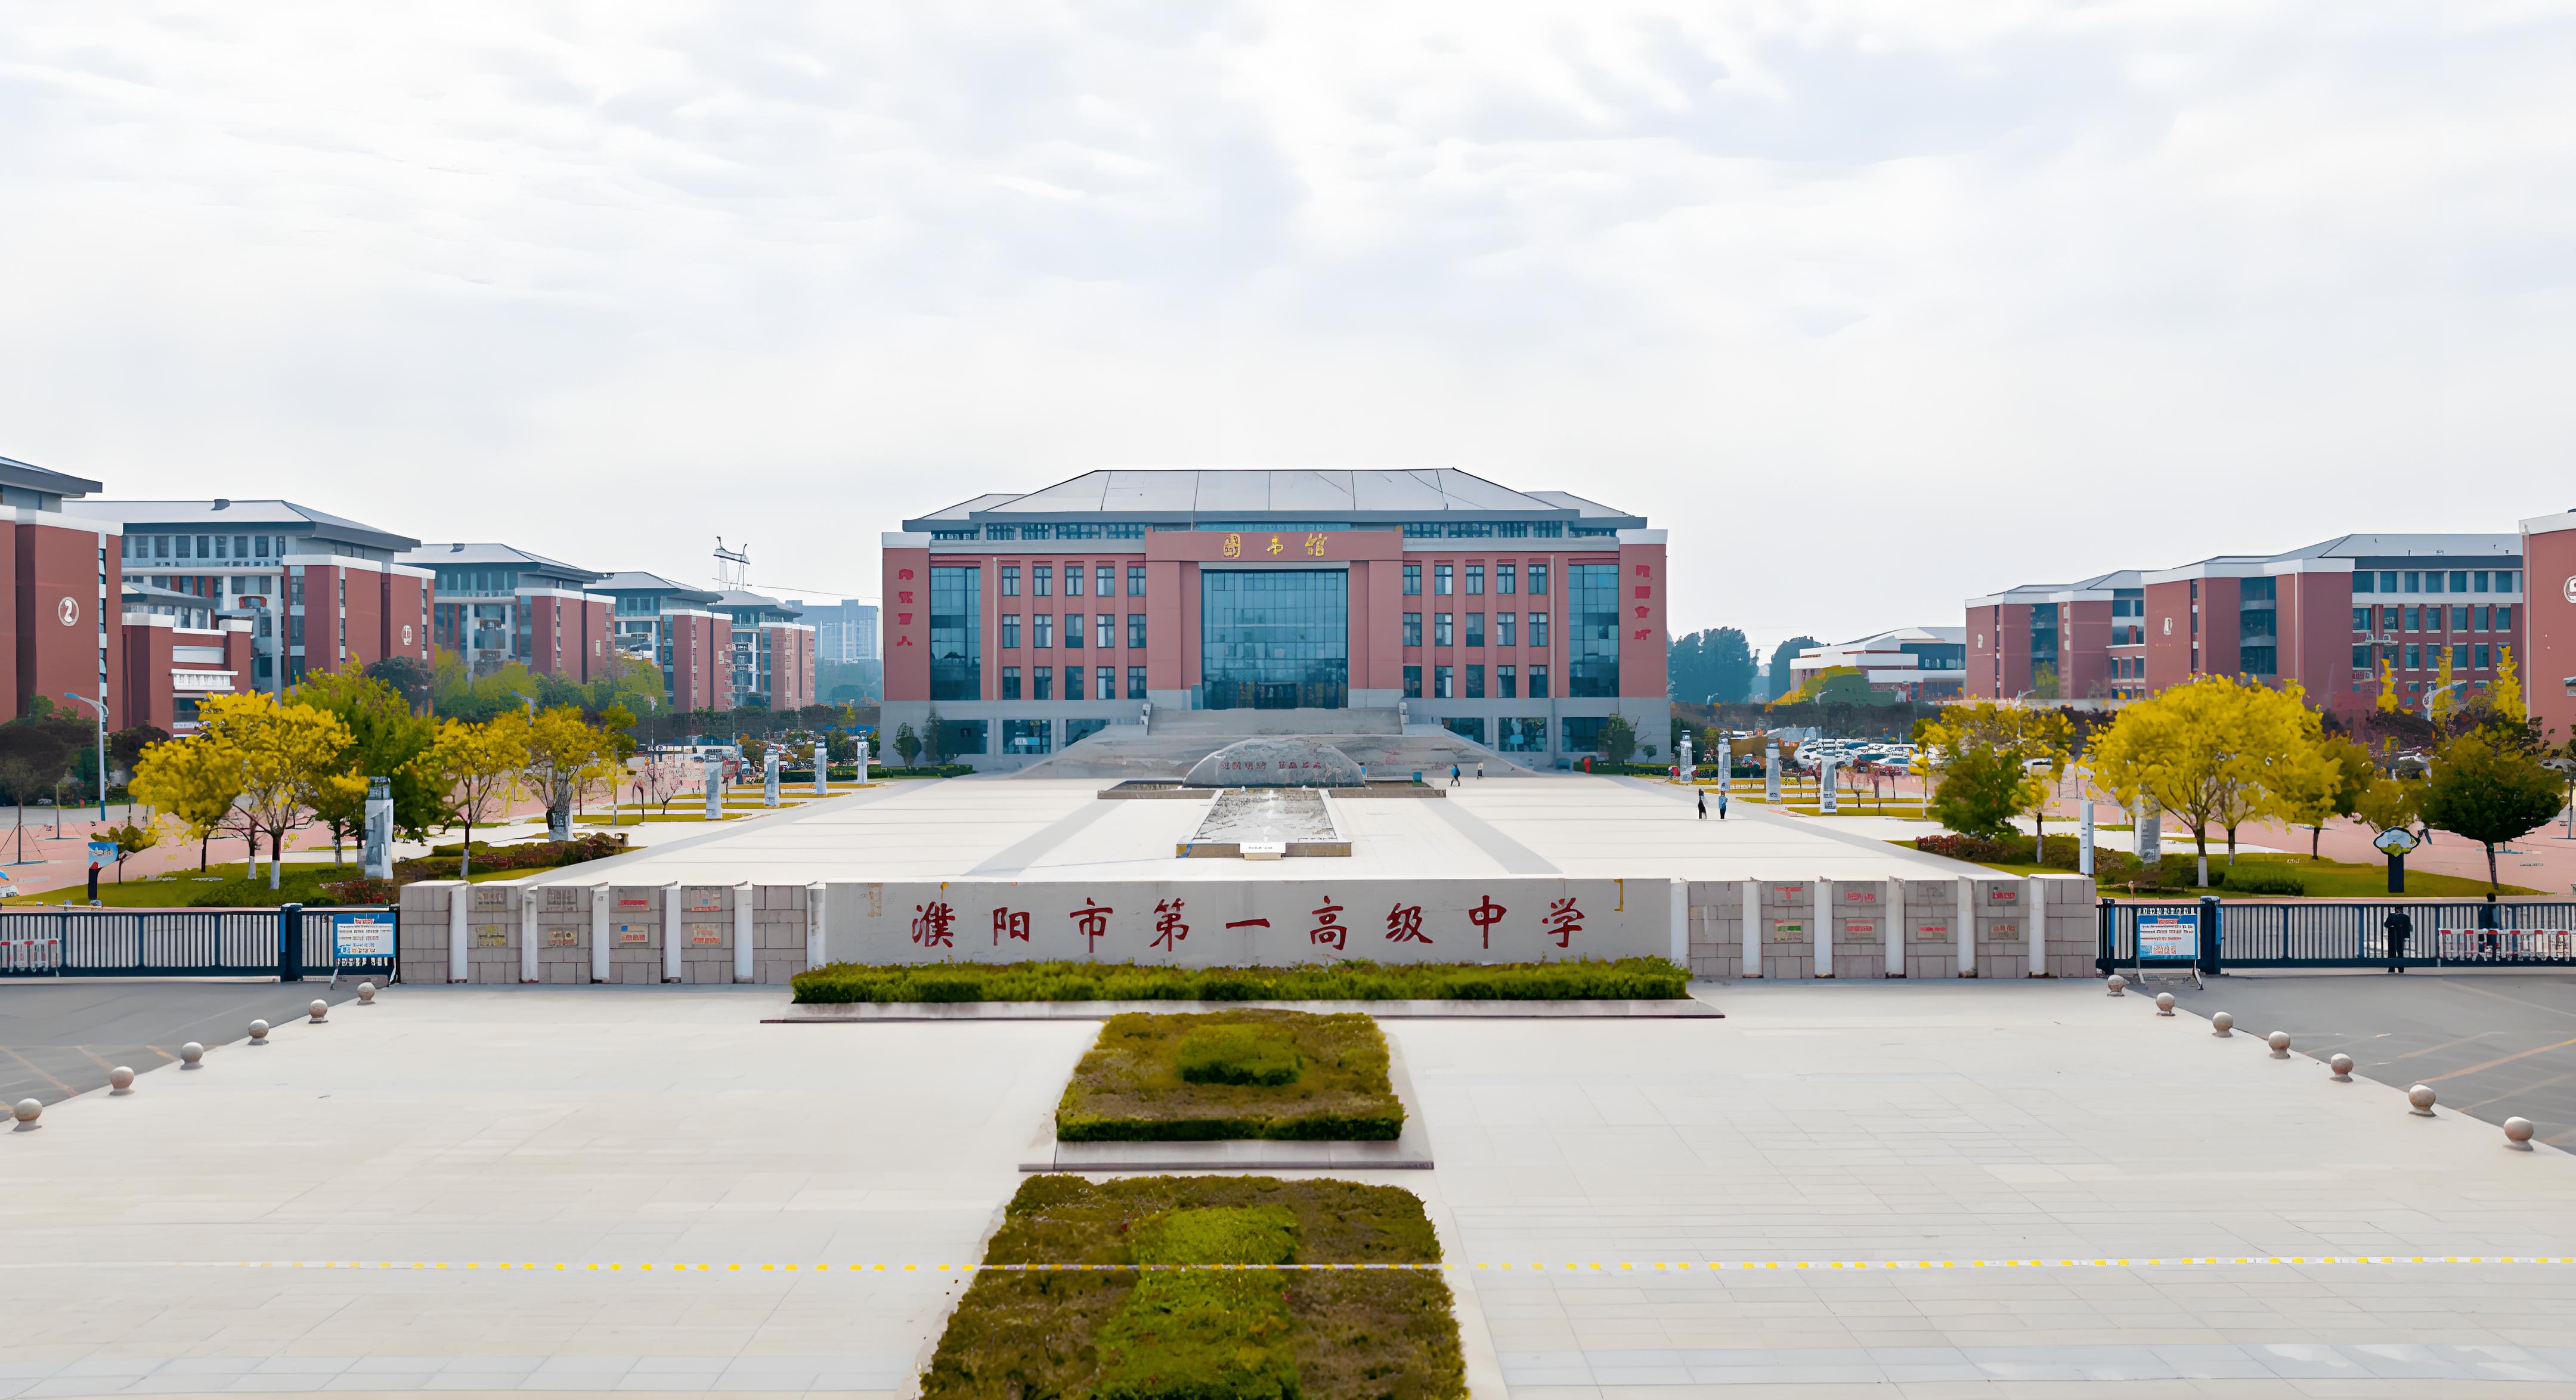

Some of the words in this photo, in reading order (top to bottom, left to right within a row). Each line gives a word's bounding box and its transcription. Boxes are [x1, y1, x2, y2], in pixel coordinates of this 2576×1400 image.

[912, 894, 1585, 953] 濮阳市第一高级中学
